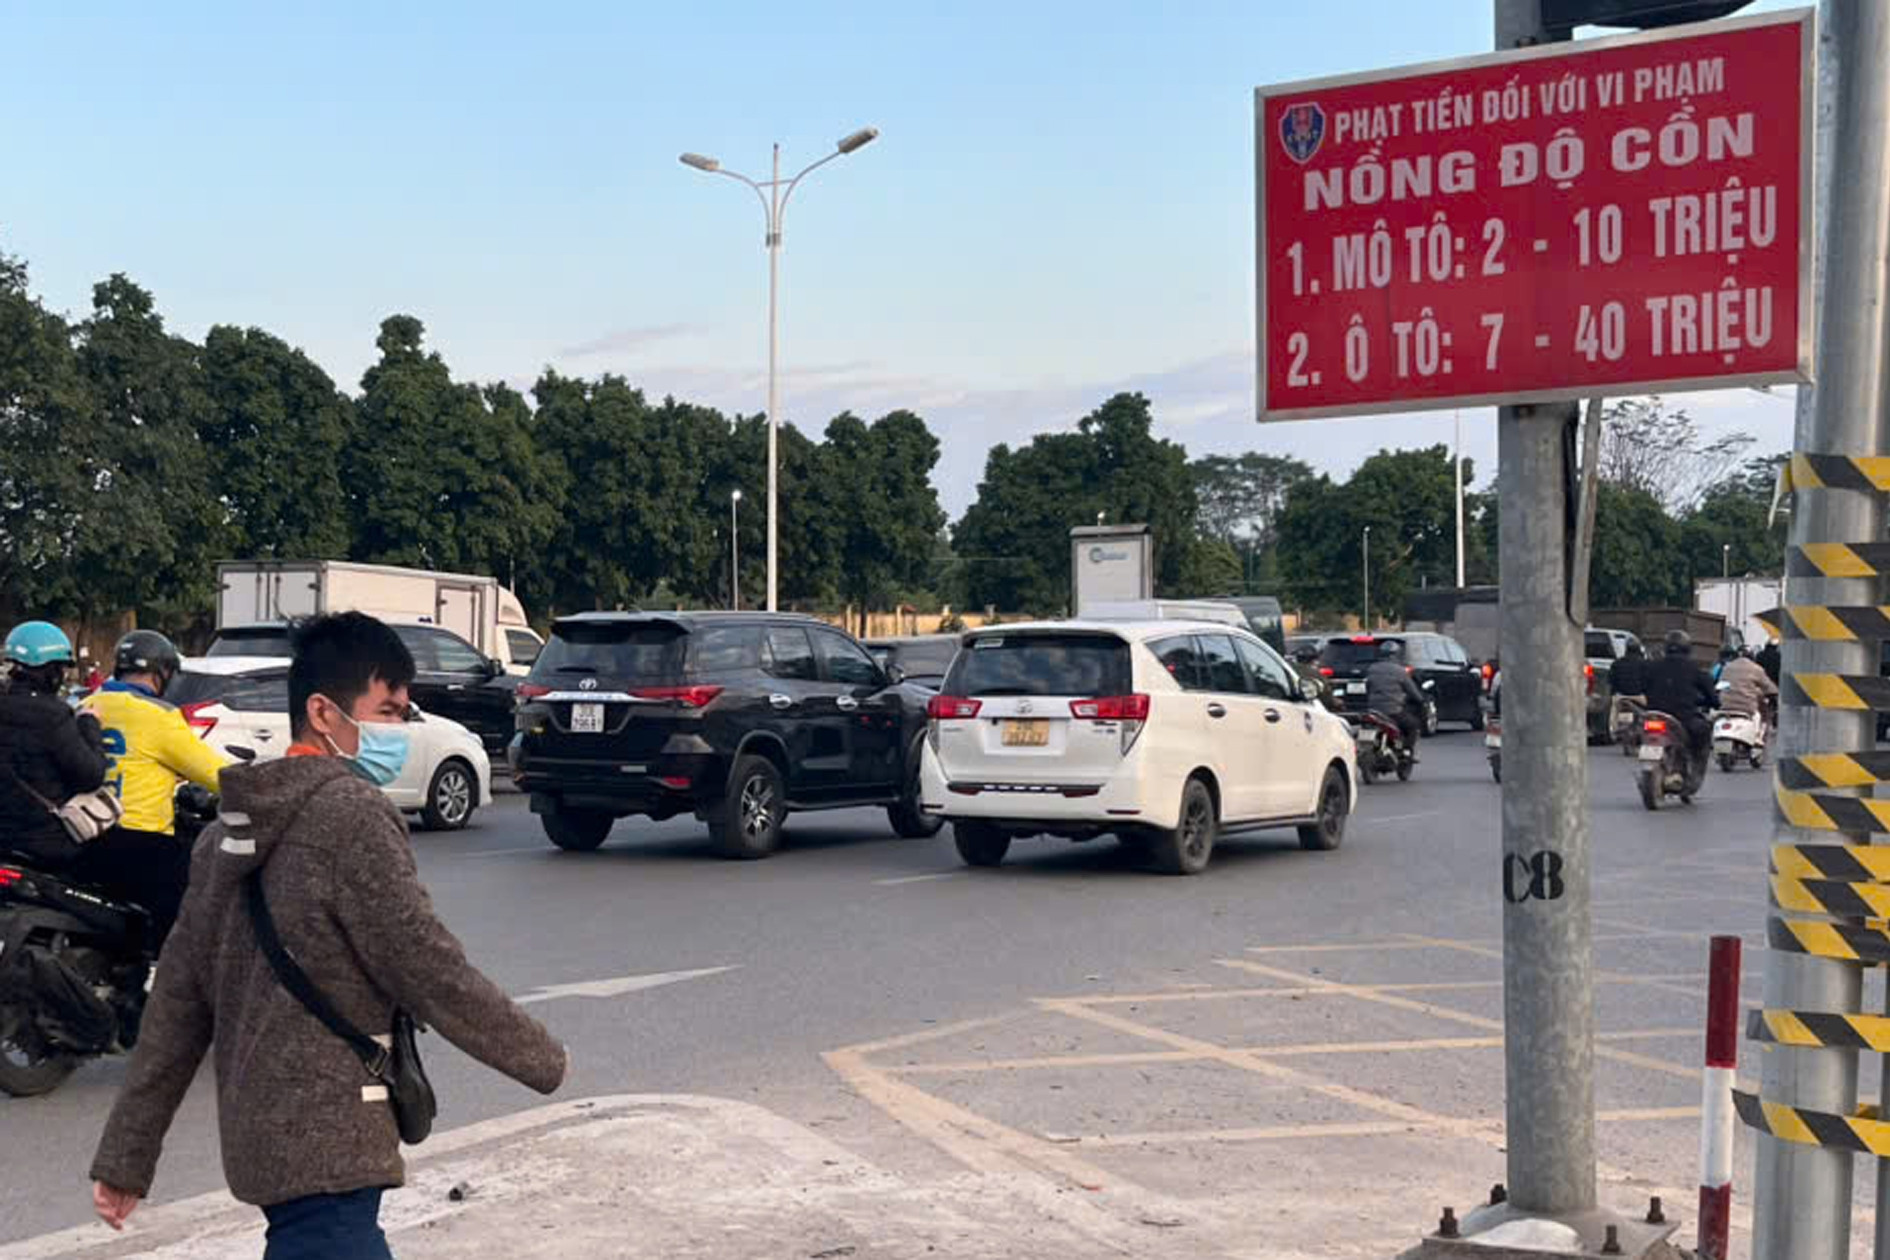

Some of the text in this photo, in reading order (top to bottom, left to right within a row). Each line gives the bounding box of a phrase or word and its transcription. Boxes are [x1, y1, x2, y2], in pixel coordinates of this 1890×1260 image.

[1335, 57, 1725, 147] PHẠT TIỀN ĐỐI VỚI VI PHẠM
[1304, 105, 1754, 210] NỒNG ĐỘ CỒN
[1288, 177, 1776, 295] 1. MÔ TÔ: 2 - 10 TRIỆU
[1288, 277, 1772, 387] 2. Ô TÔ: 7 - 40 TRIỆU
[1503, 851, 1564, 903] C8
